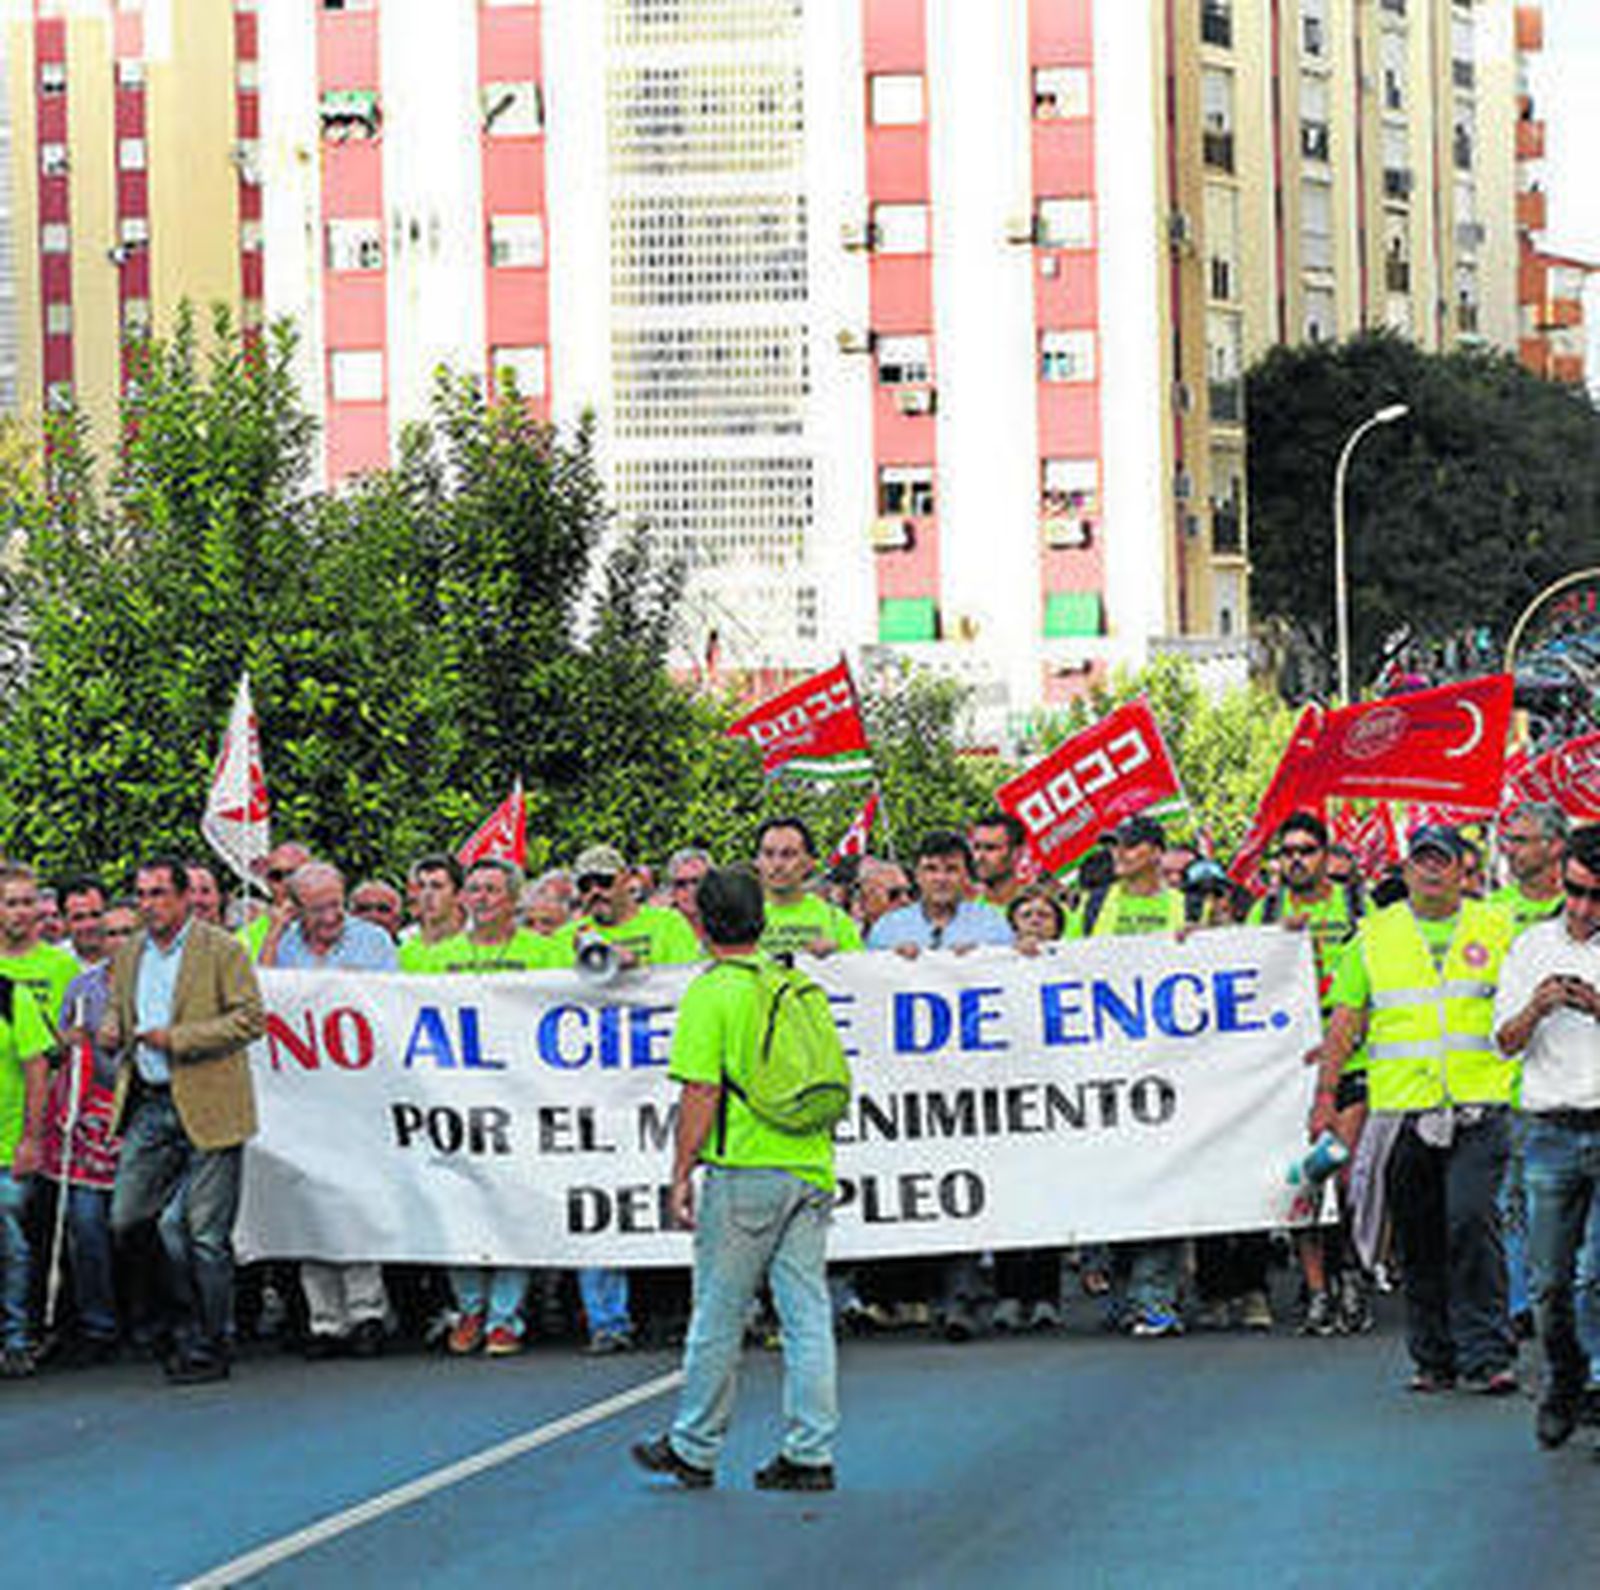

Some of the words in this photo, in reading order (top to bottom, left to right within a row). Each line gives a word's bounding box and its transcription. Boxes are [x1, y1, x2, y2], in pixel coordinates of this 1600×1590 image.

[264, 1006, 375, 1071] NO
[404, 1006, 507, 1070] AL
[893, 987, 1010, 1055] DE
[1041, 968, 1290, 1046] ENCE.
[393, 1101, 511, 1154] POR
[538, 1105, 616, 1153] EL
